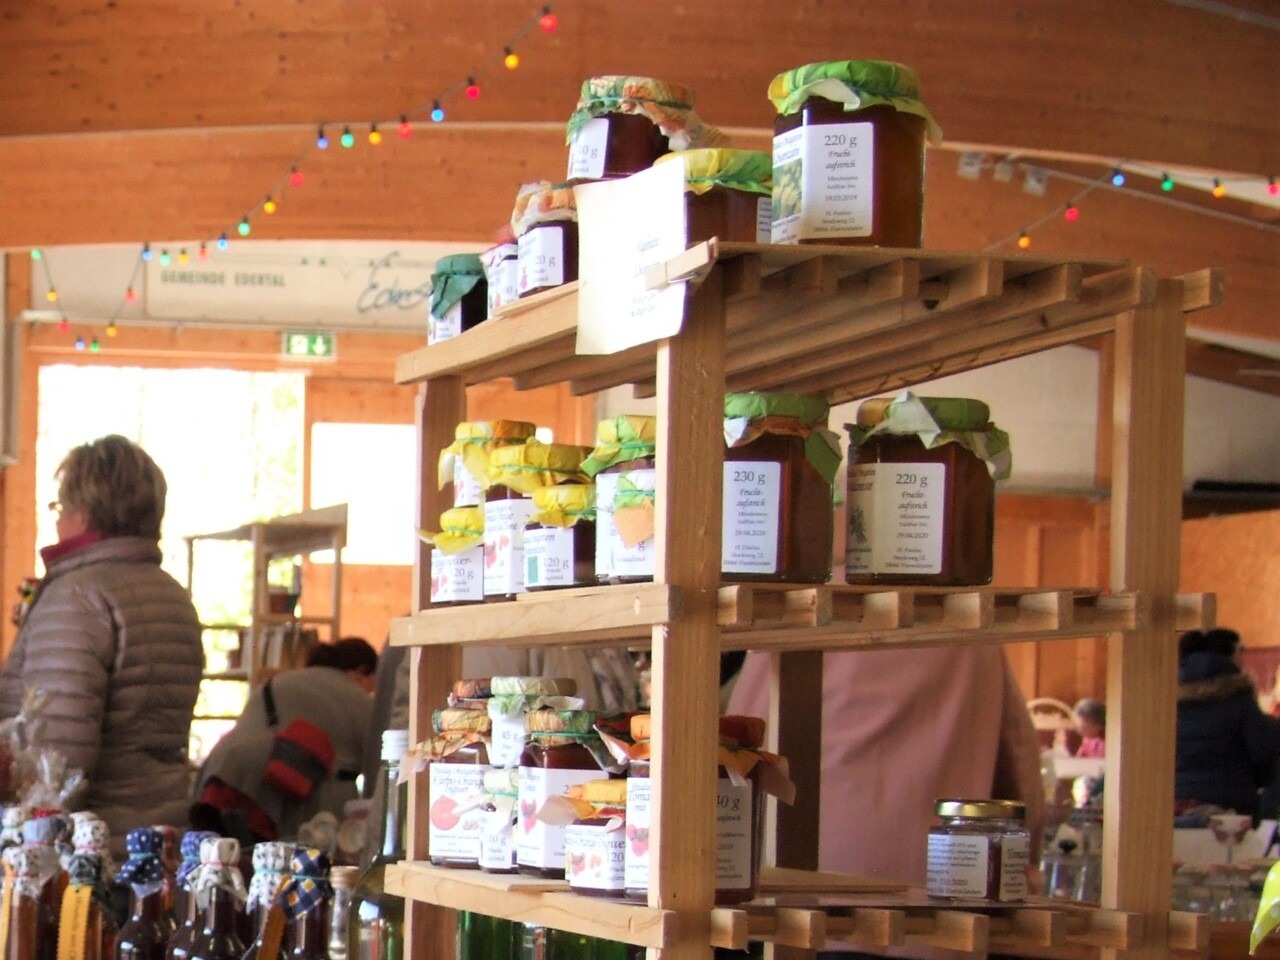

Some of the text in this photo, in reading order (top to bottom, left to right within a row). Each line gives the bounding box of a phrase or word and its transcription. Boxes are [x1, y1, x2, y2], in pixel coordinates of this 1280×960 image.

[824, 134, 858, 148] 220 g
[161, 270, 286, 287] GEMEINDE EDERTAL
[733, 470, 766, 485] 230 g
[895, 473, 928, 488] 220 g
[562, 559, 569, 569] g
